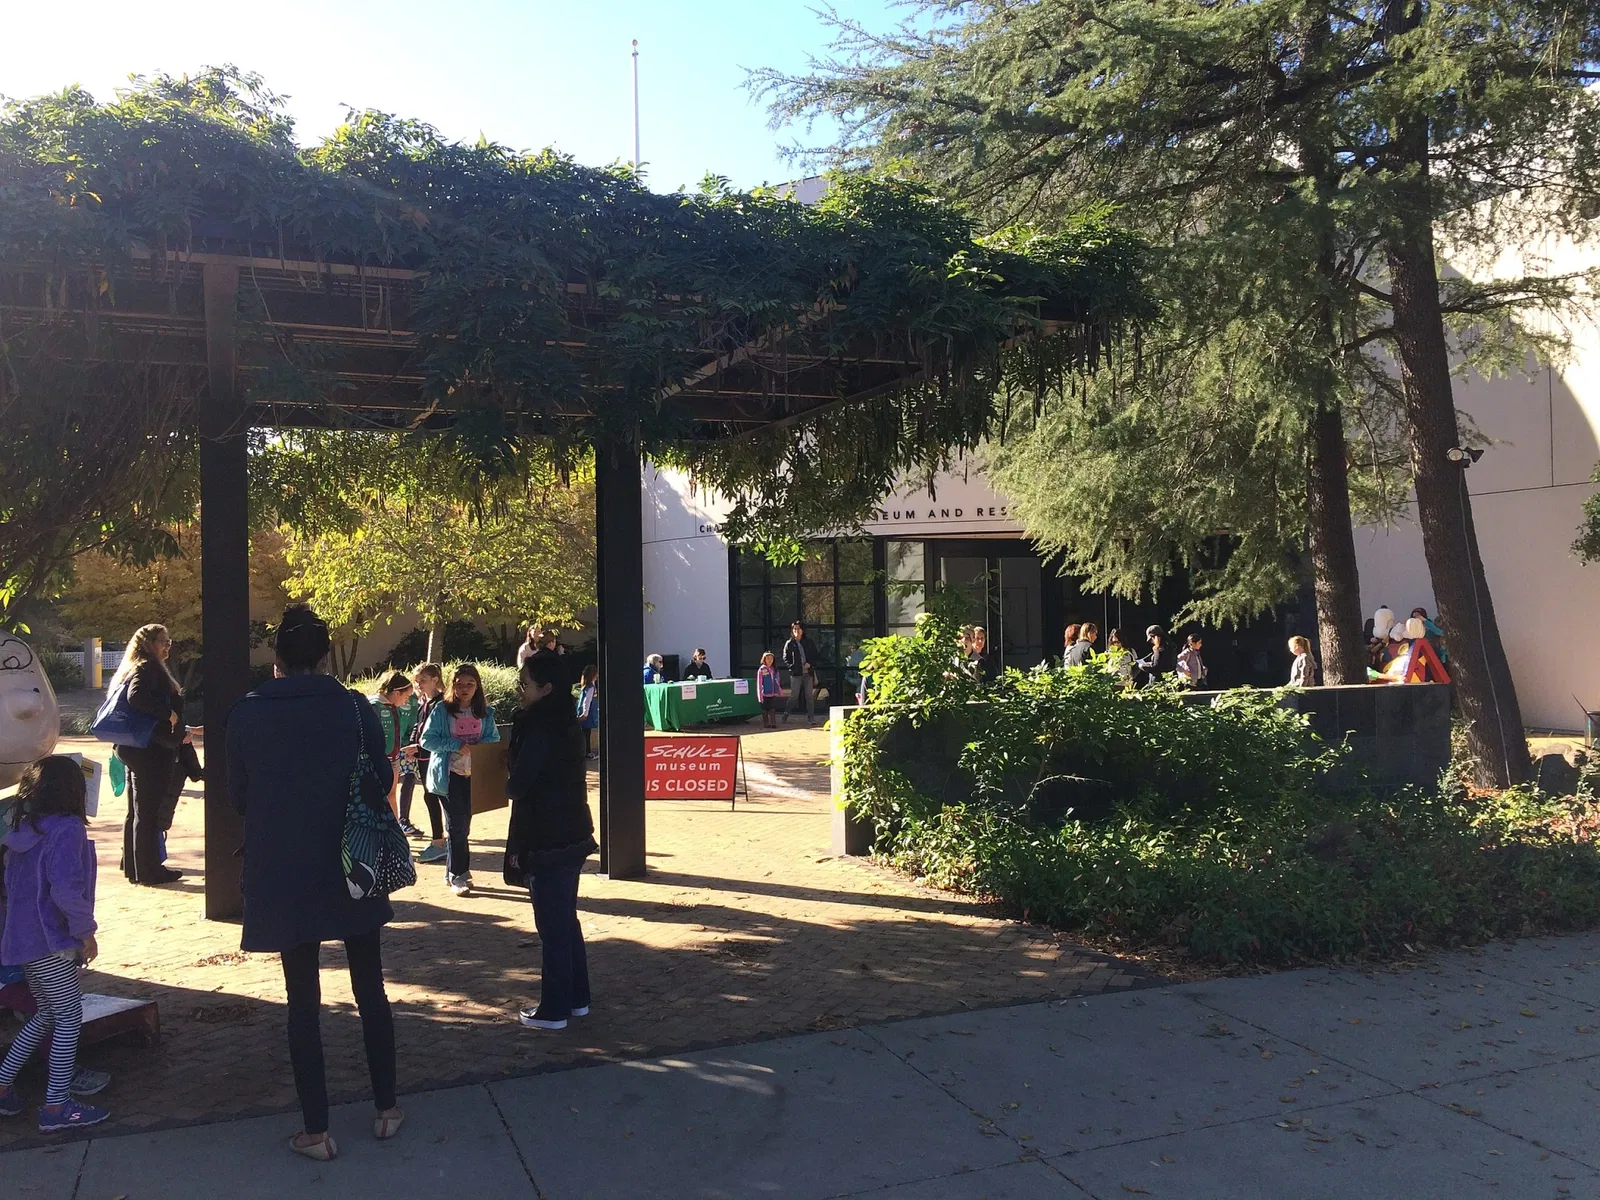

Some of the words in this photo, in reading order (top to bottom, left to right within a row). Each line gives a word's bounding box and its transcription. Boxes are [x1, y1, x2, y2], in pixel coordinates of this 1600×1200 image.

[928, 508, 963, 518] AND
[976, 506, 1010, 517] RES
[655, 762, 720, 771] museum
[646, 779, 660, 792] IS
[665, 779, 729, 792] CLOSED
